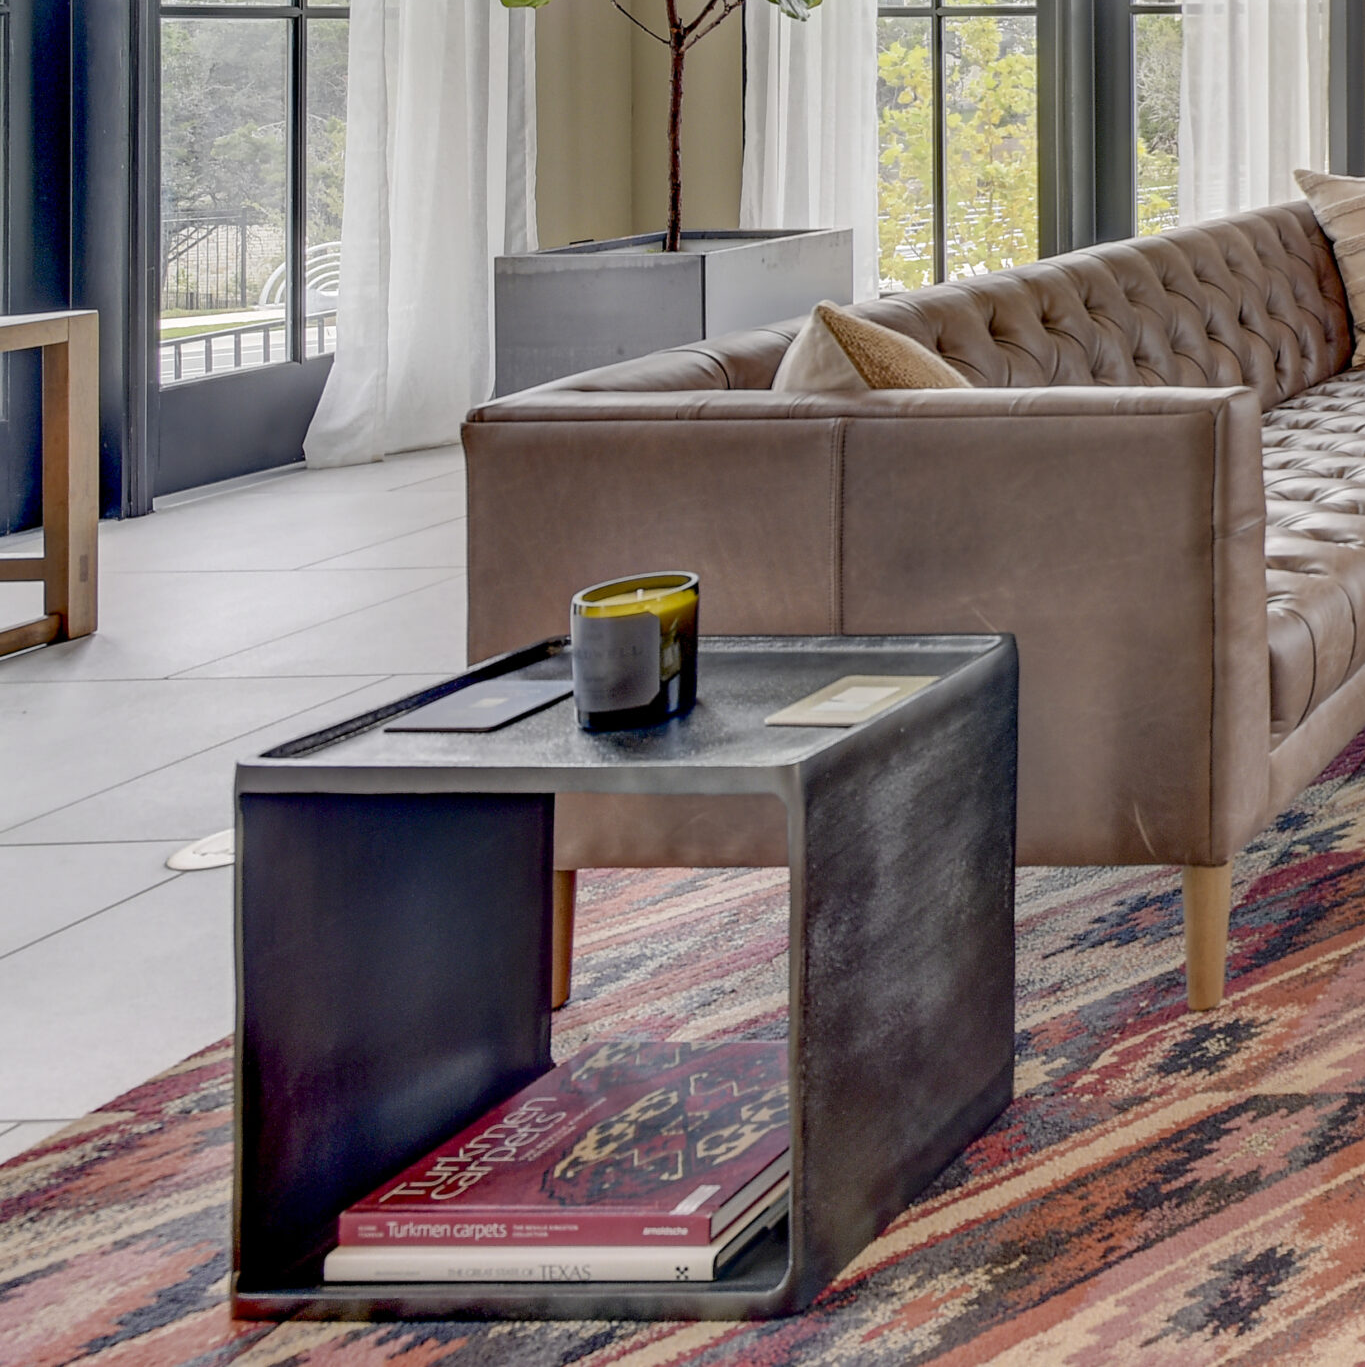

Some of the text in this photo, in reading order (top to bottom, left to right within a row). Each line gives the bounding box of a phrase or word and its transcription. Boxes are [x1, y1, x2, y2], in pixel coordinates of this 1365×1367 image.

[379, 1097, 557, 1203] Turkmen
[430, 1111, 567, 1200] carpets
[386, 1221, 450, 1238] Turkmen
[453, 1222, 507, 1240] carpets
[538, 1264, 591, 1280] TEXAS
